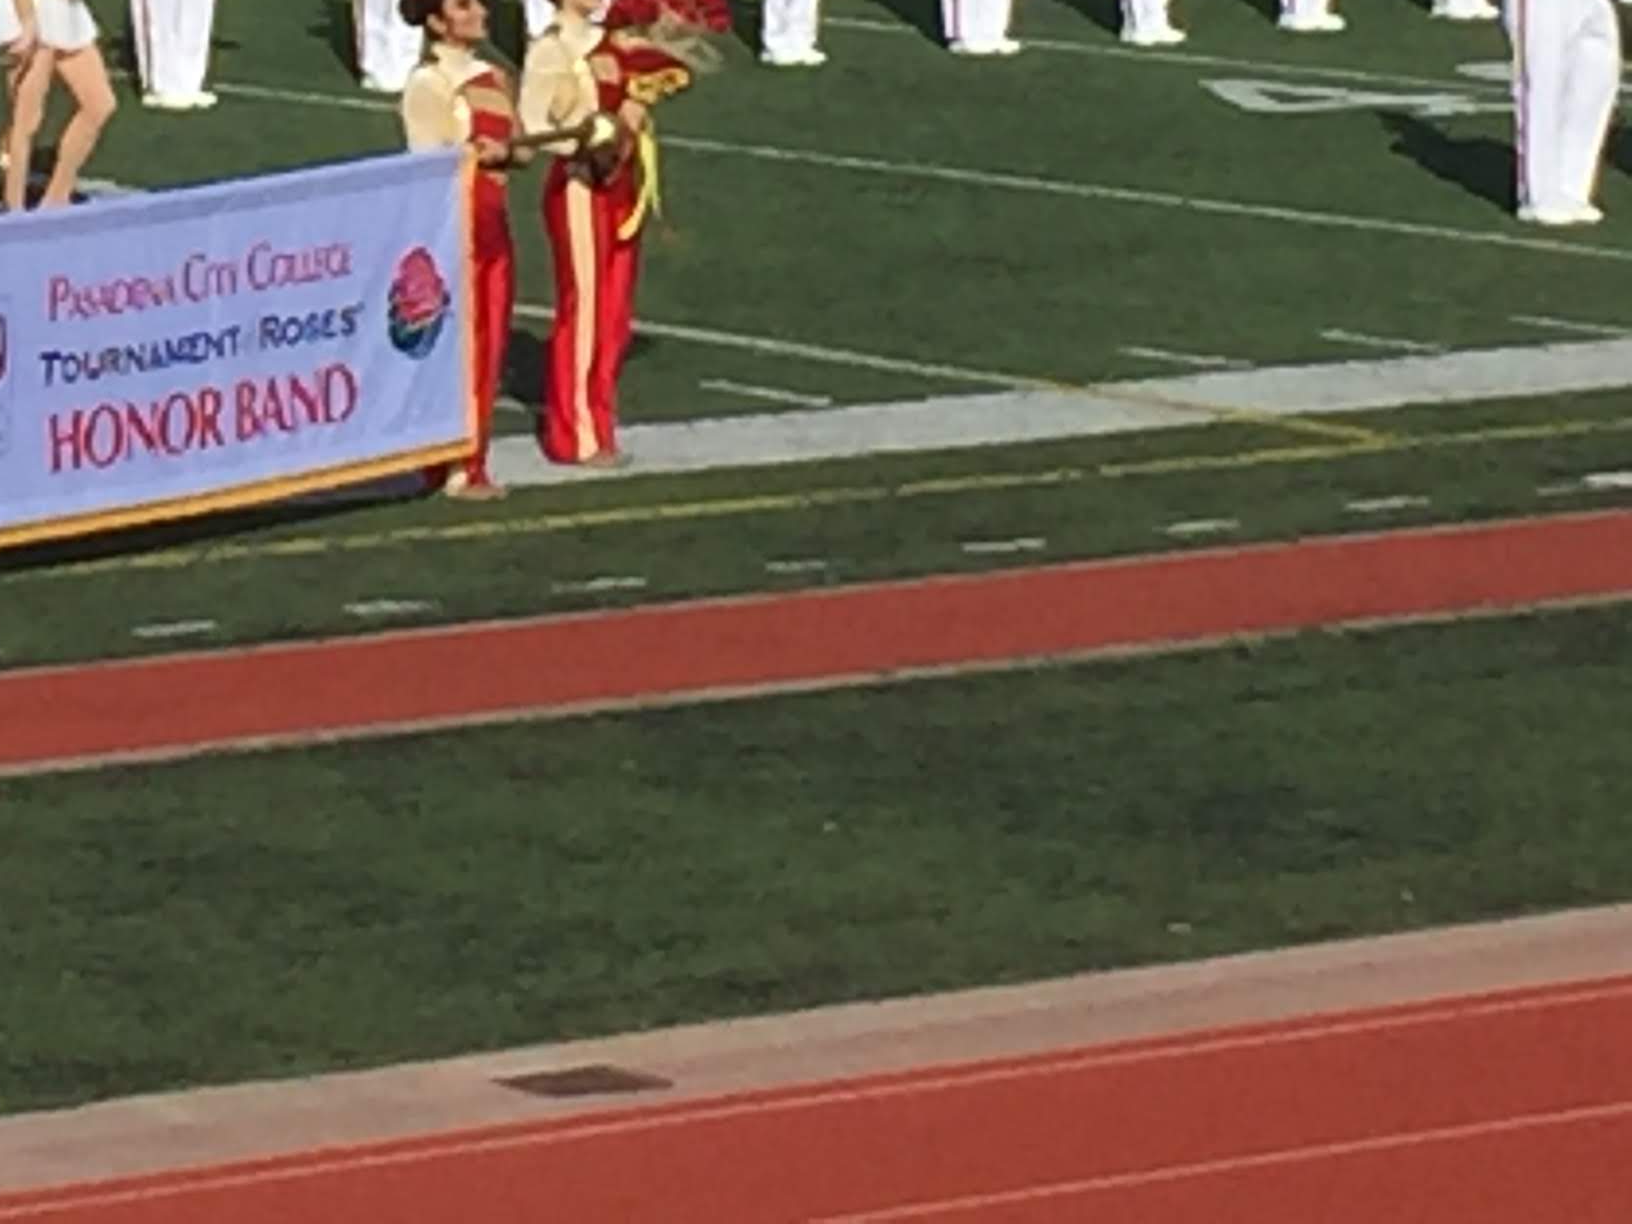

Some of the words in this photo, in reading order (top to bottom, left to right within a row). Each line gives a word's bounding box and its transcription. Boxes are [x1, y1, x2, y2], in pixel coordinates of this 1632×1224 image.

[40, 325, 241, 387] TOURNAMENT
[49, 387, 225, 472] HONOR
[235, 363, 357, 443] BAND
